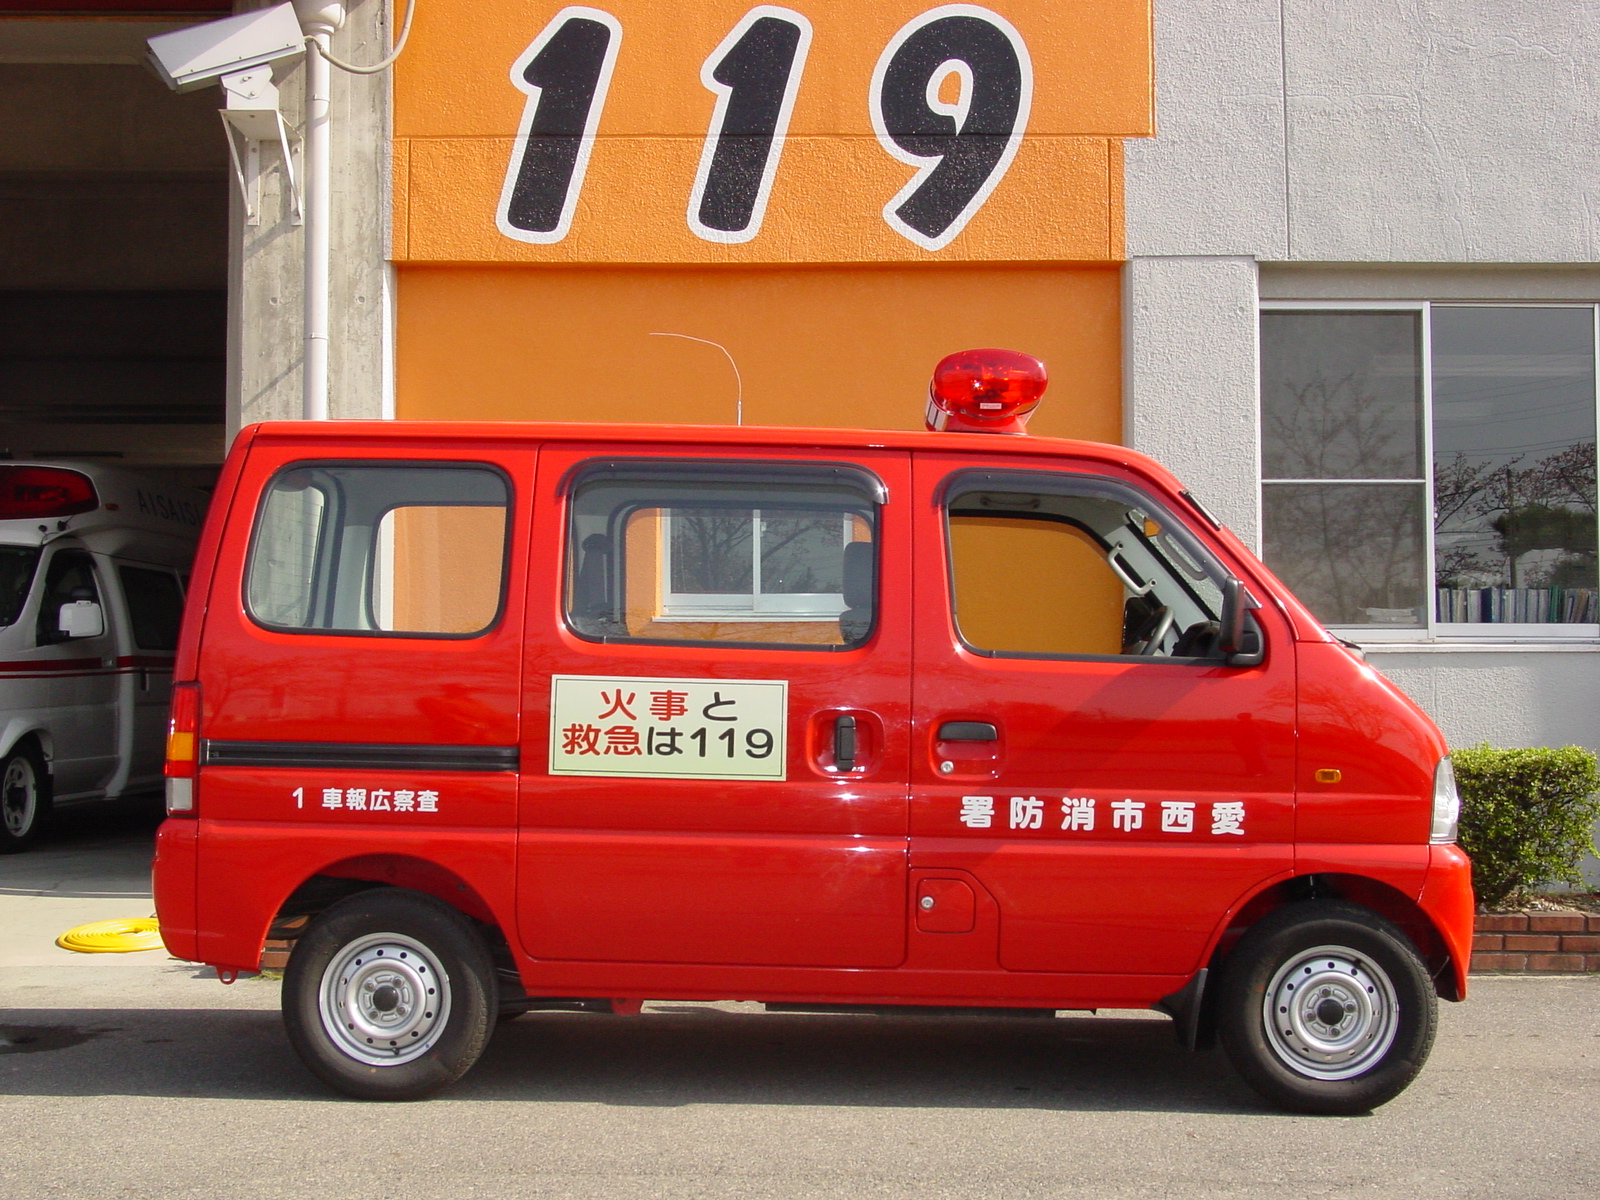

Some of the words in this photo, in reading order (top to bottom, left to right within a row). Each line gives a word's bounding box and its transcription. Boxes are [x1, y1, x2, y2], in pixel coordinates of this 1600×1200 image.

[496, 4, 1034, 252] 119
[597, 688, 739, 722] 火事と
[562, 723, 775, 760] 救急は119
